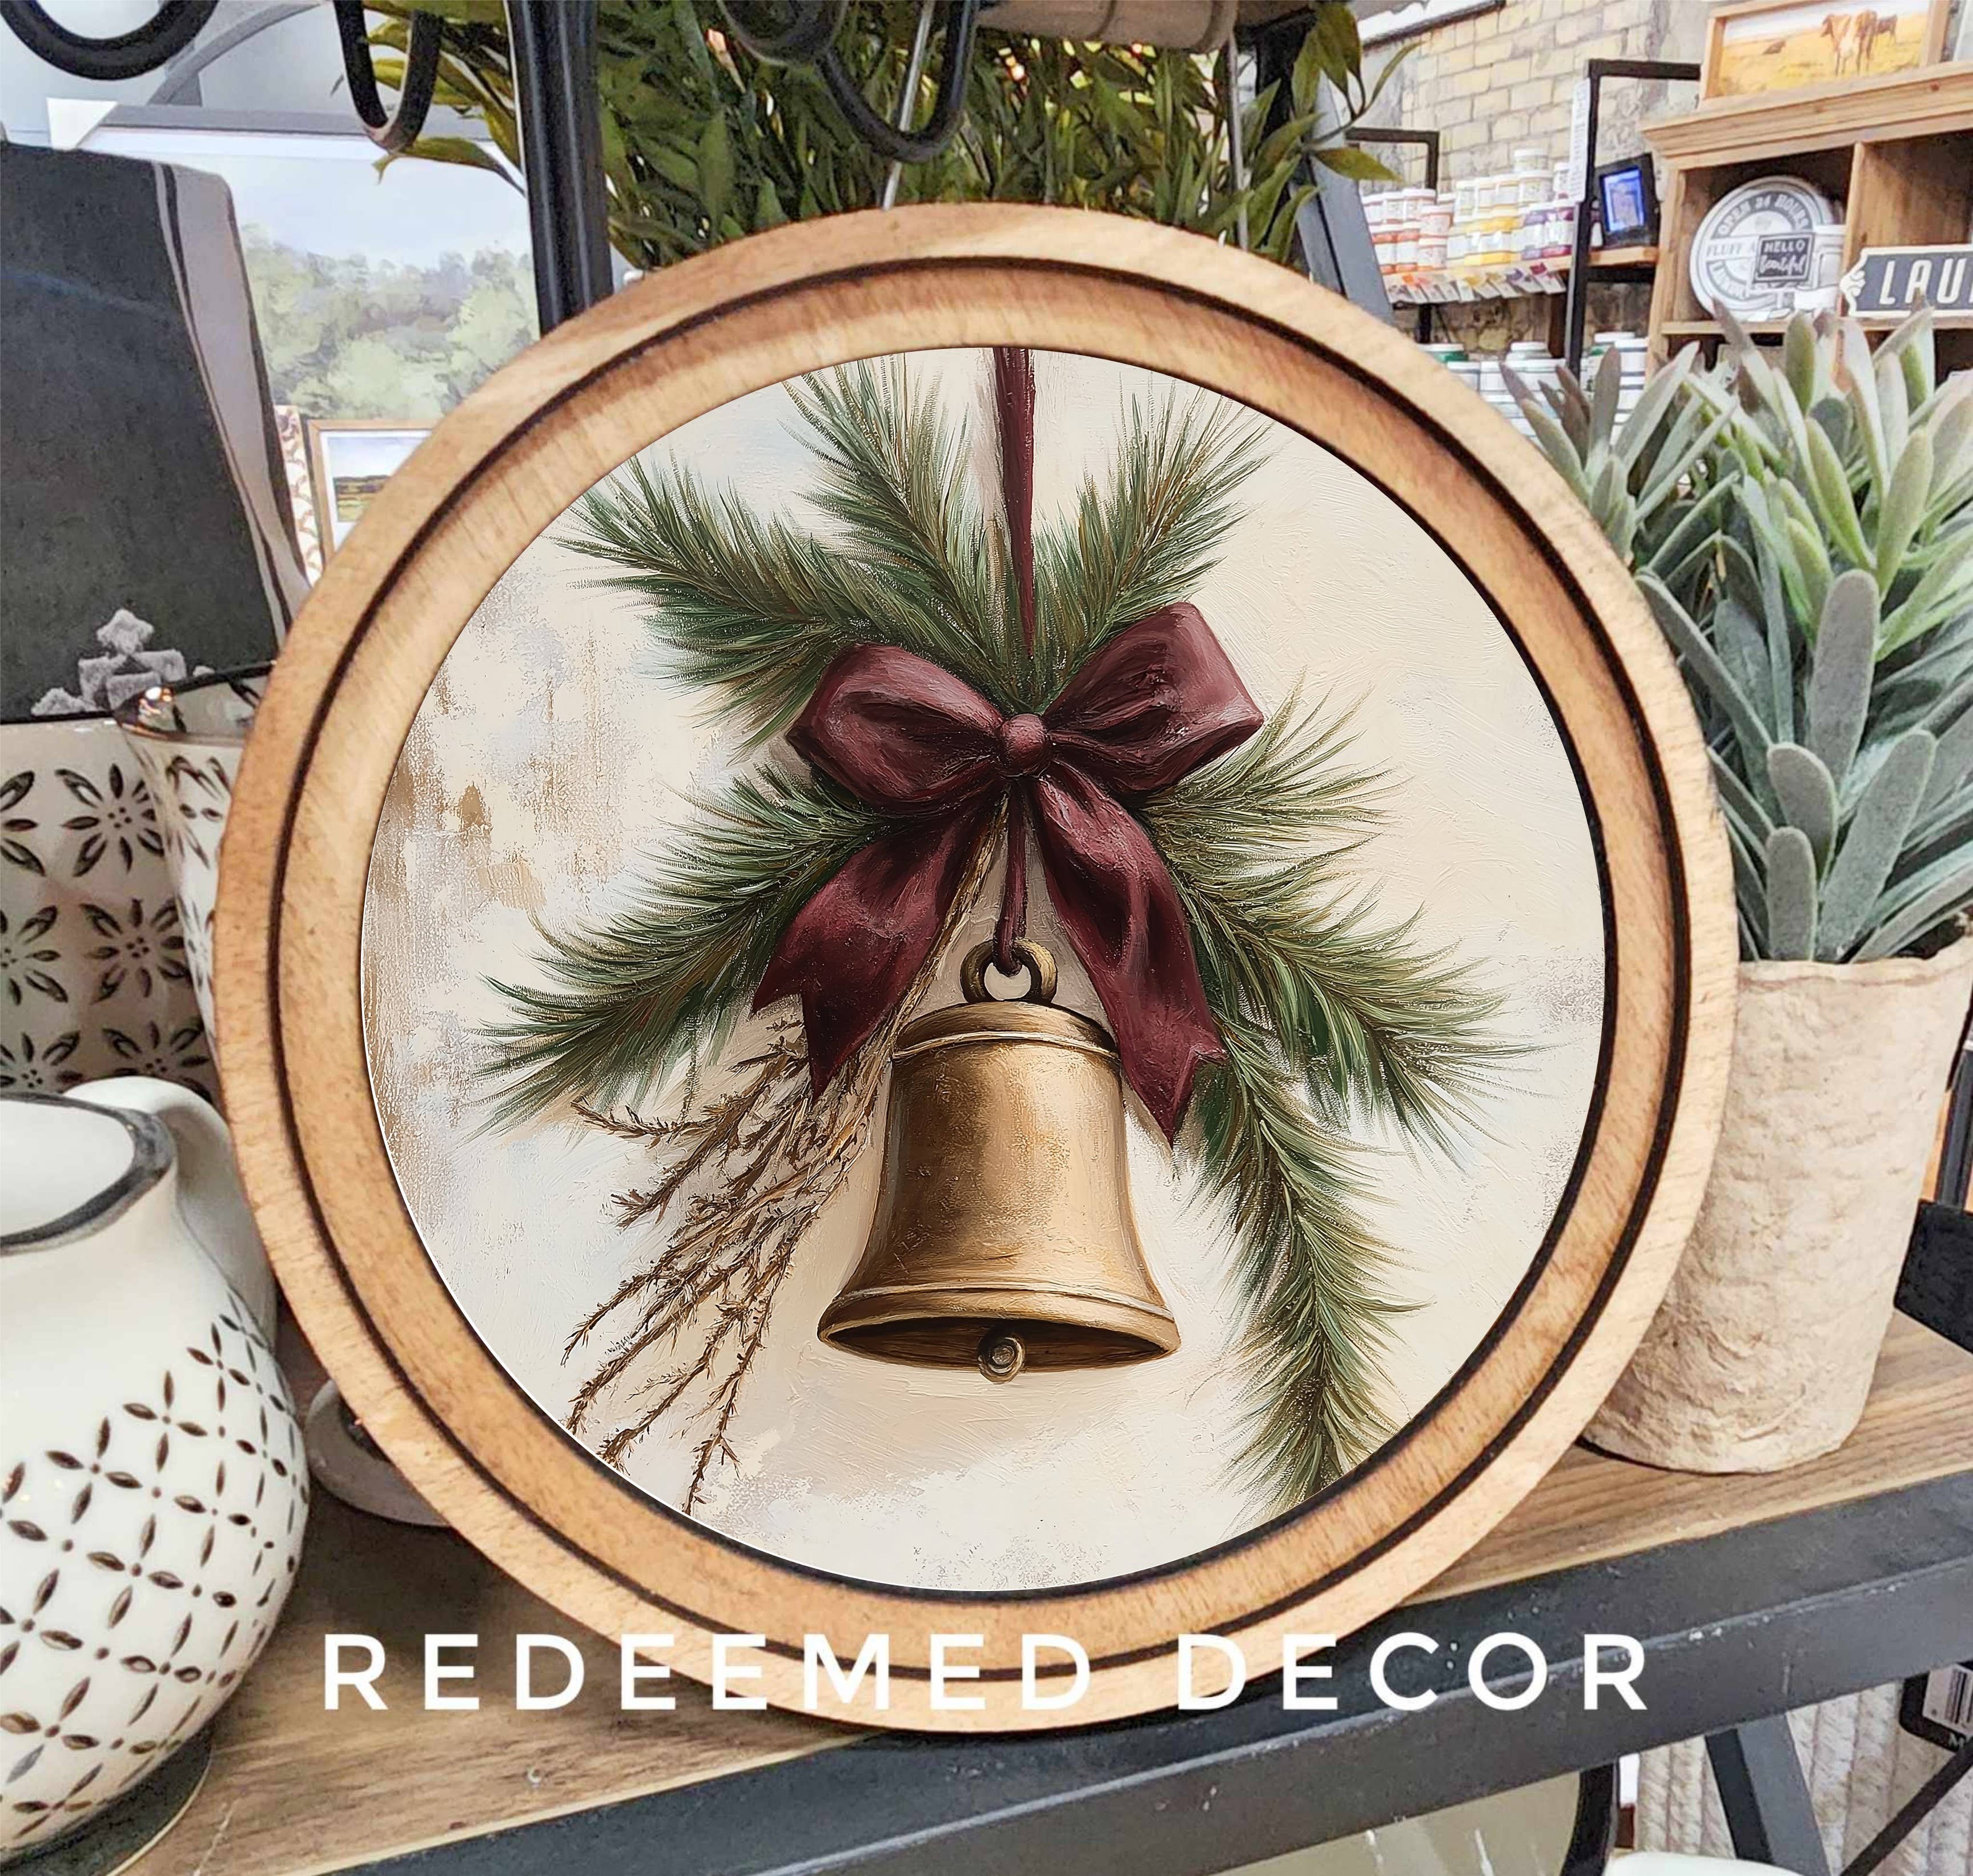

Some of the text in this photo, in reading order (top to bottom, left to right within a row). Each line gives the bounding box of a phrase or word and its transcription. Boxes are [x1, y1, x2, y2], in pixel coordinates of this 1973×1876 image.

[1718, 200, 1751, 235] OPEN
[1774, 194, 1810, 230] HOURS
[1763, 239, 1806, 252] HELLO
[1879, 258, 1973, 305] LAU
